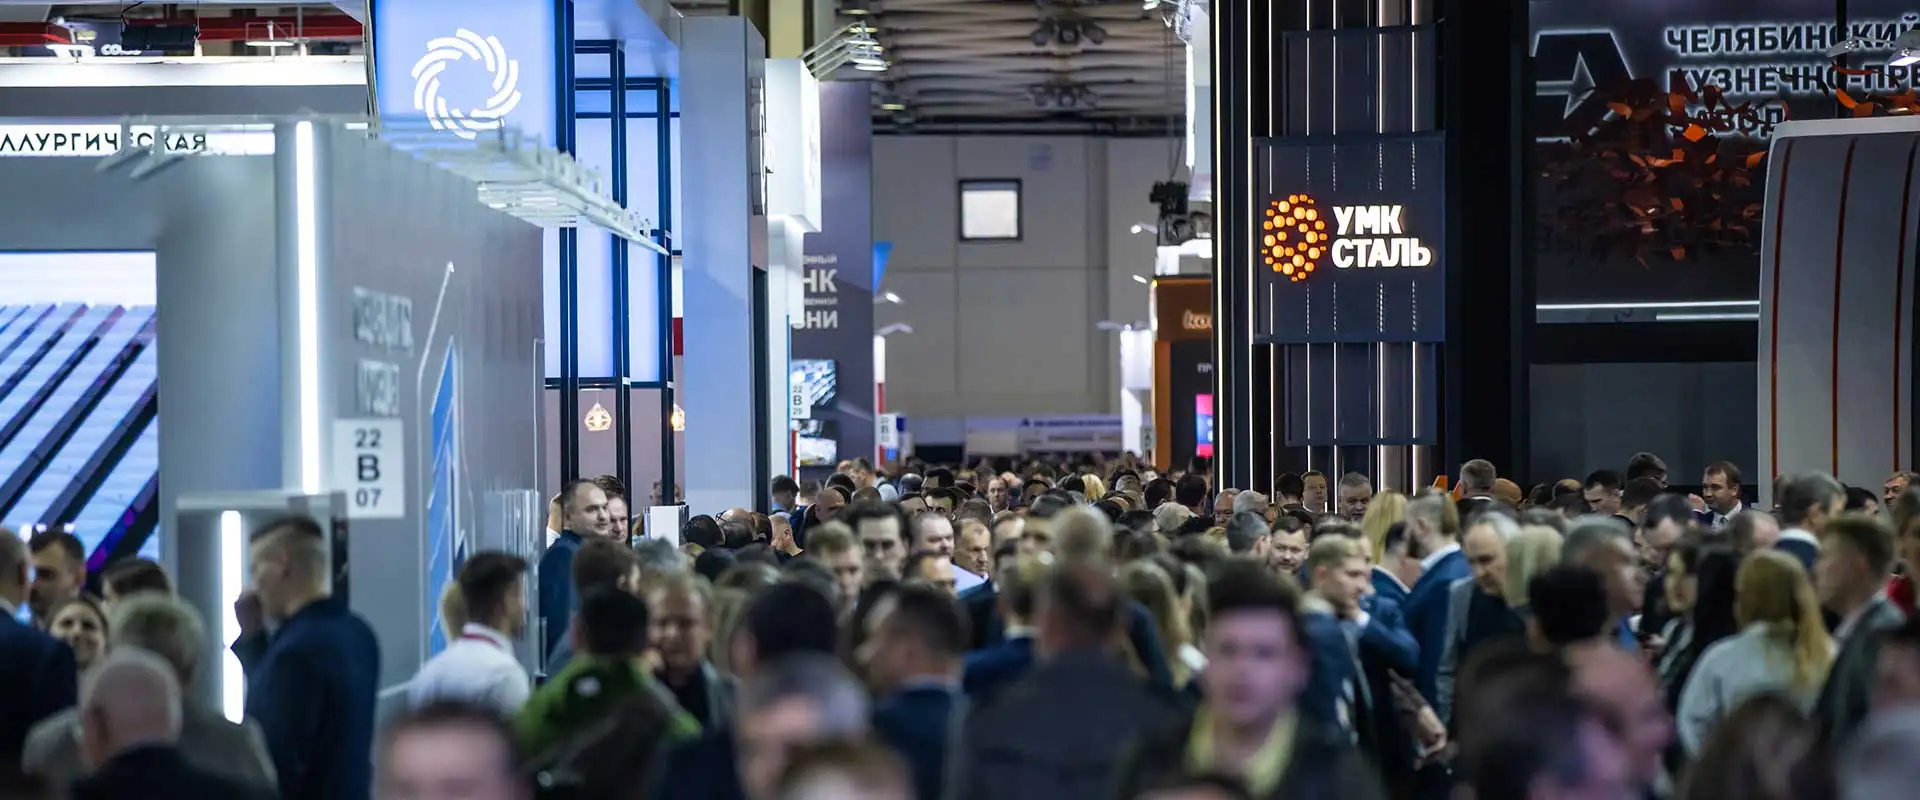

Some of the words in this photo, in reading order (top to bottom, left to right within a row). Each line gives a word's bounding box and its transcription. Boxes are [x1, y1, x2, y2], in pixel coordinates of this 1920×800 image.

[0, 133, 206, 151] ЛЛУРГИЧСКАЯ
[1332, 205, 1402, 235] УМК
[1331, 238, 1432, 268] СТАЛЬ
[355, 430, 382, 448] 22
[355, 489, 382, 507] 07
